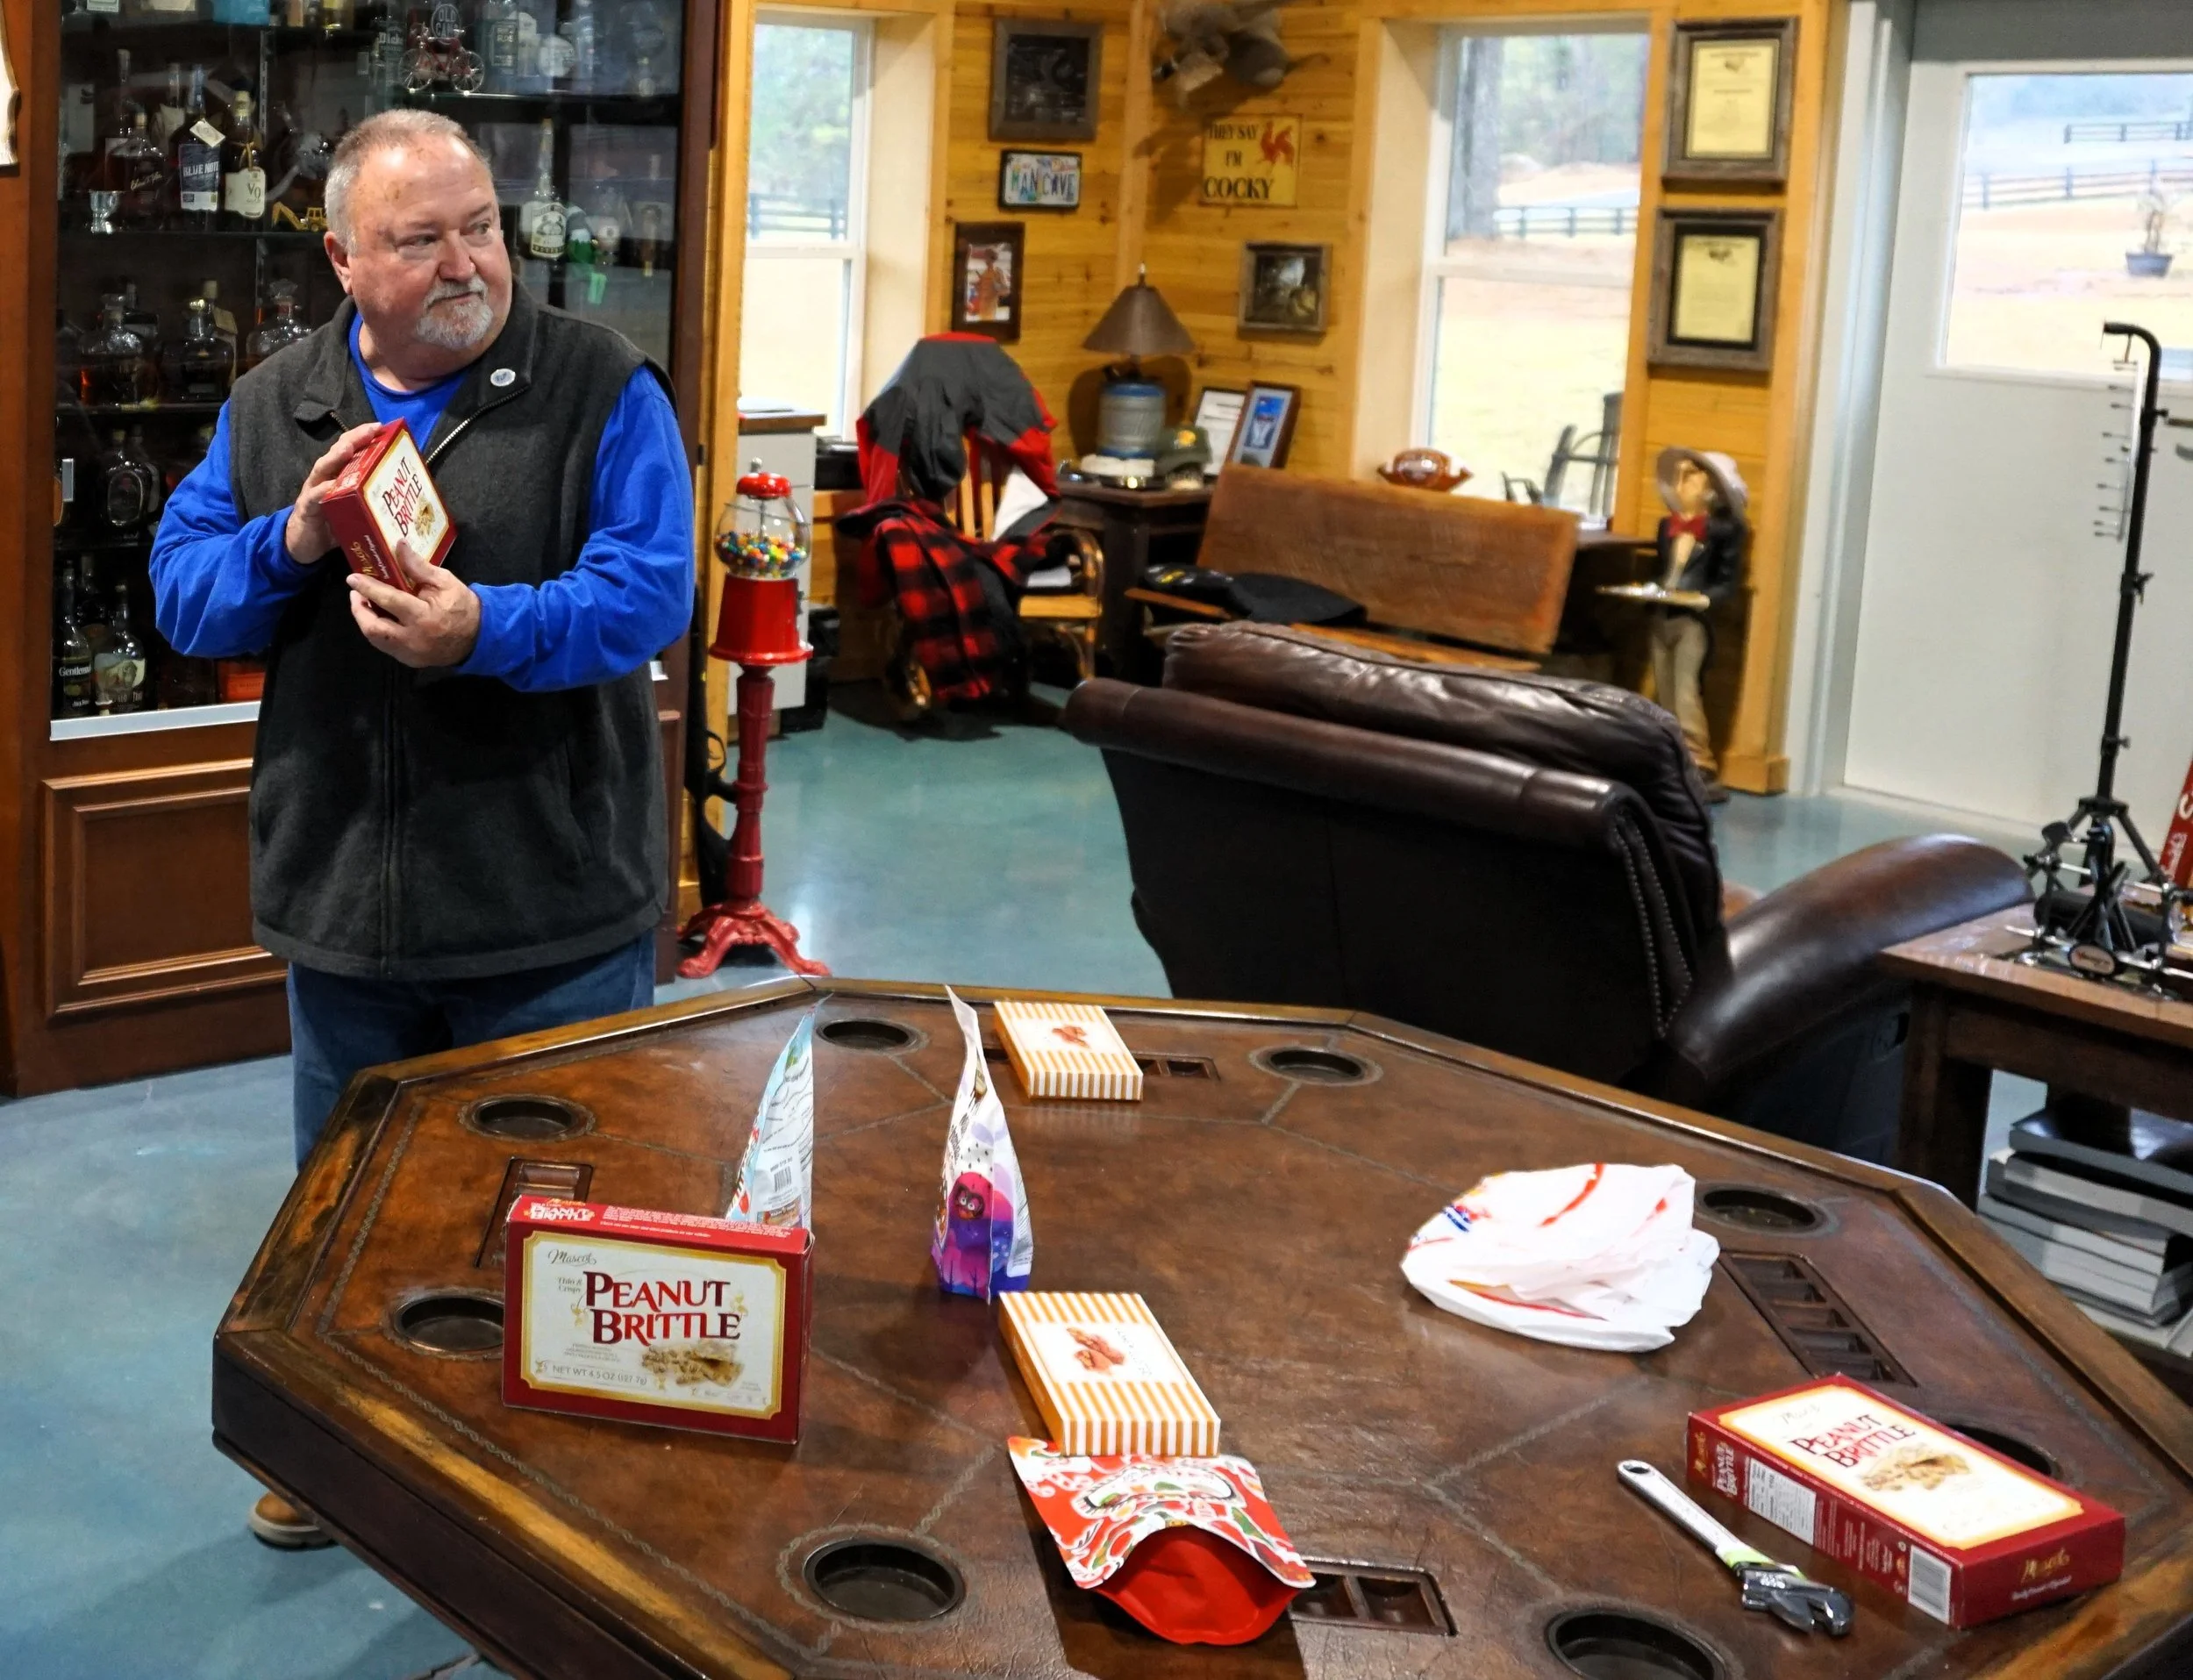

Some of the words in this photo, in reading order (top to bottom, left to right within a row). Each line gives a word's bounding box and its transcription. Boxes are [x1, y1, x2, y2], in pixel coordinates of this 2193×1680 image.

[438, 7, 457, 22] OLD
[1208, 124, 1233, 139] THEY
[1237, 124, 1259, 139] SAY
[183, 164, 204, 177] BLUE
[1225, 150, 1242, 167] I'M
[1010, 168, 1039, 196] MAN
[1042, 172, 1075, 201] CAVE
[1204, 177, 1274, 199] COCKY
[382, 456, 411, 517] PEANUT
[394, 474, 423, 537] BRITTLE
[547, 1248, 597, 1265] Mascot
[582, 1270, 731, 1312] PEANUT
[589, 1308, 741, 1347] BRITTLE
[553, 1364, 571, 1375] NET
[573, 1368, 587, 1376] WT
[1788, 1414, 1882, 1455] PEANUT
[1820, 1425, 1916, 1469] BRITTLE
